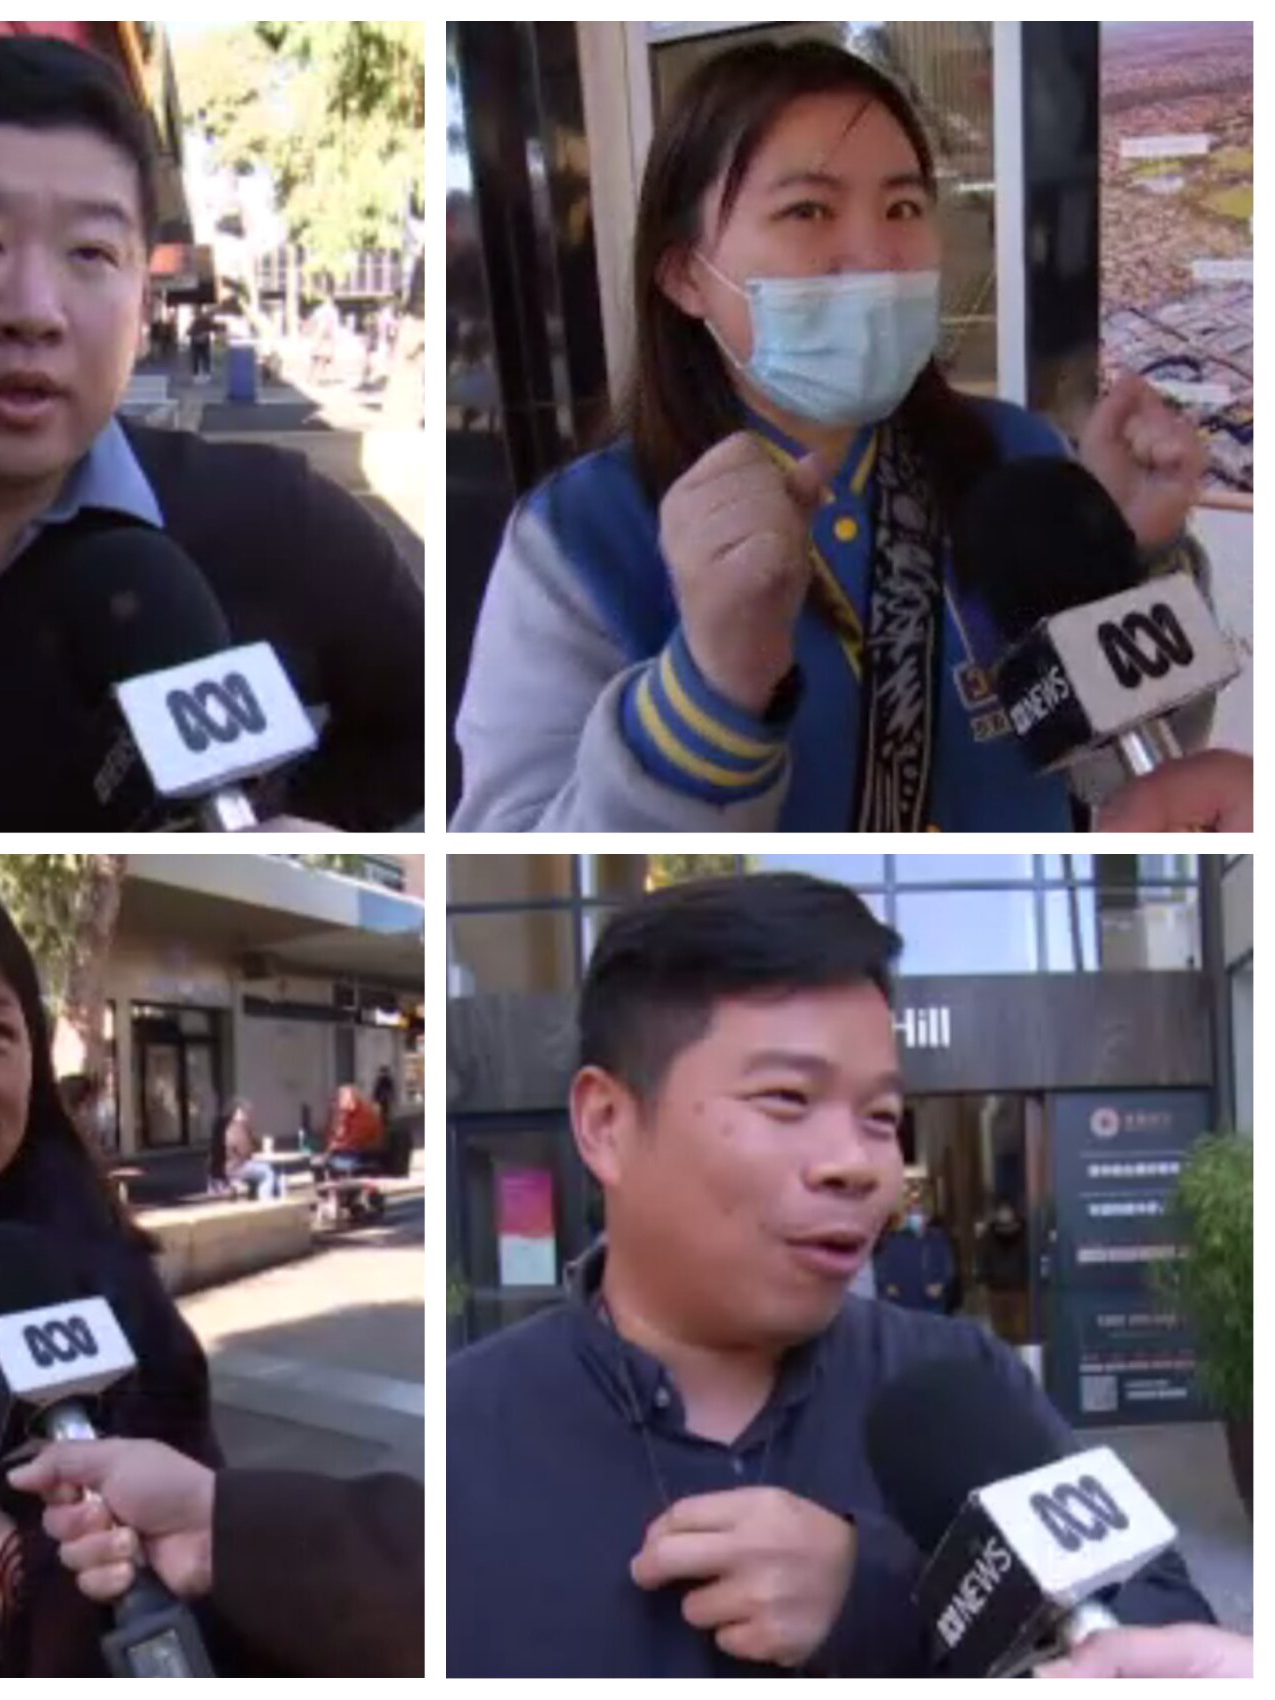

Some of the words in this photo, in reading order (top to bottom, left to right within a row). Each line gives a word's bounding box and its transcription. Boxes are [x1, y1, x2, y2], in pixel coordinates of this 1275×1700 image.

[1023, 665, 1069, 721] NEWS
[890, 1006, 950, 1048] Hill
[952, 1536, 1011, 1624] NEWS
